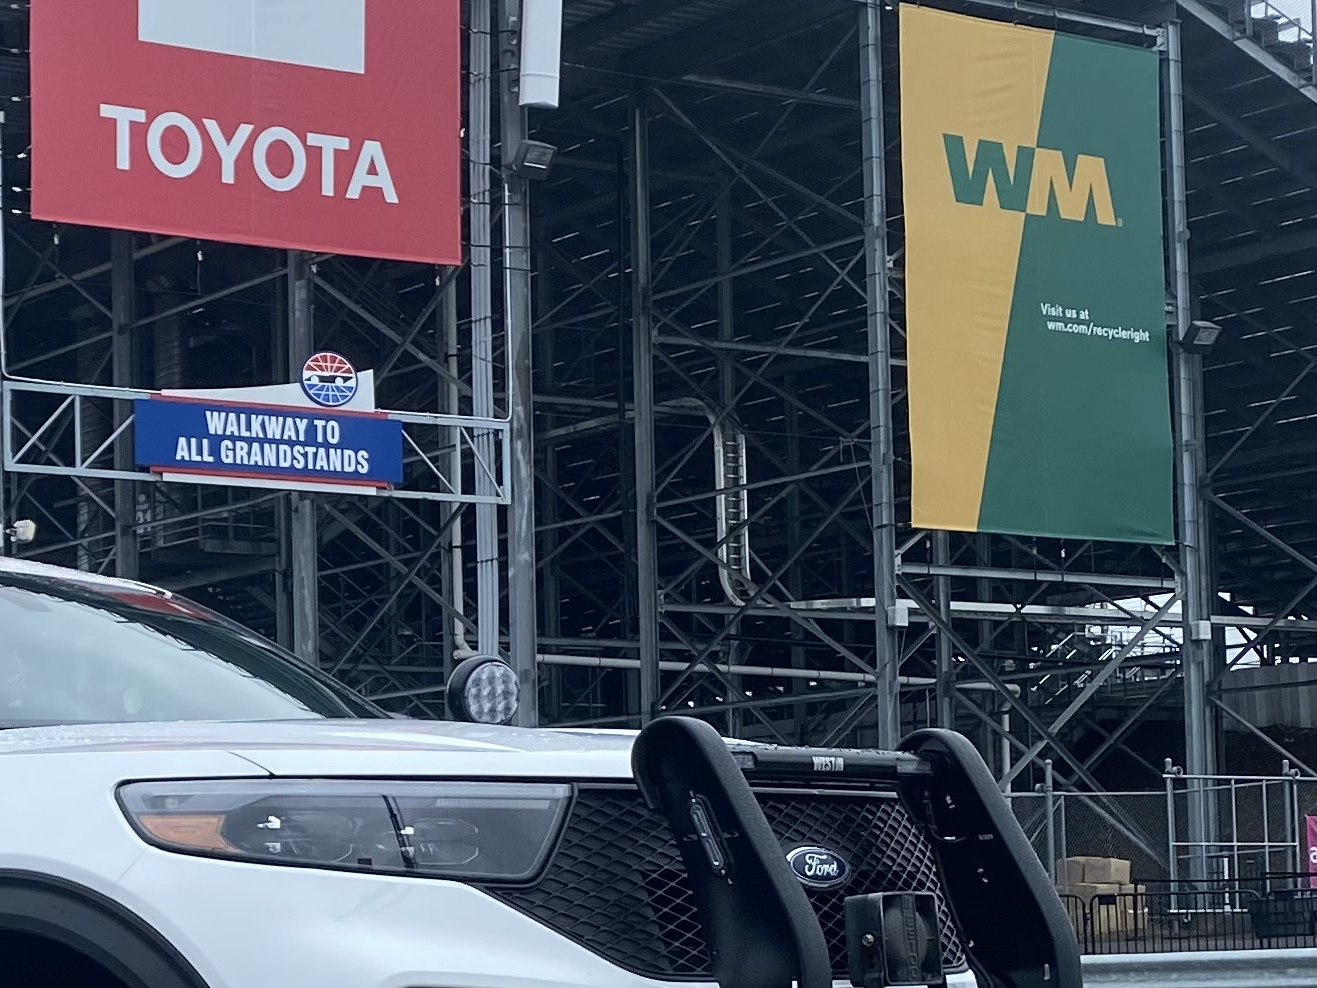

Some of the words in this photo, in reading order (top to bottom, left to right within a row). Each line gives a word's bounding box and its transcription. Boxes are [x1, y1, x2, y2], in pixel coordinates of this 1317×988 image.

[99, 103, 400, 205] TOYOTA
[942, 132, 1117, 227] WM
[1040, 302, 1064, 317] Visit
[1065, 308, 1077, 319] us
[1079, 309, 1090, 320] at
[1046, 320, 1150, 343] wm.com/recycleright
[204, 410, 309, 441] WALKWAY
[313, 419, 340, 444] TO
[175, 436, 214, 462] ALL
[220, 439, 370, 474] GRANDSTANDS
[804, 853, 840, 876] Ford
